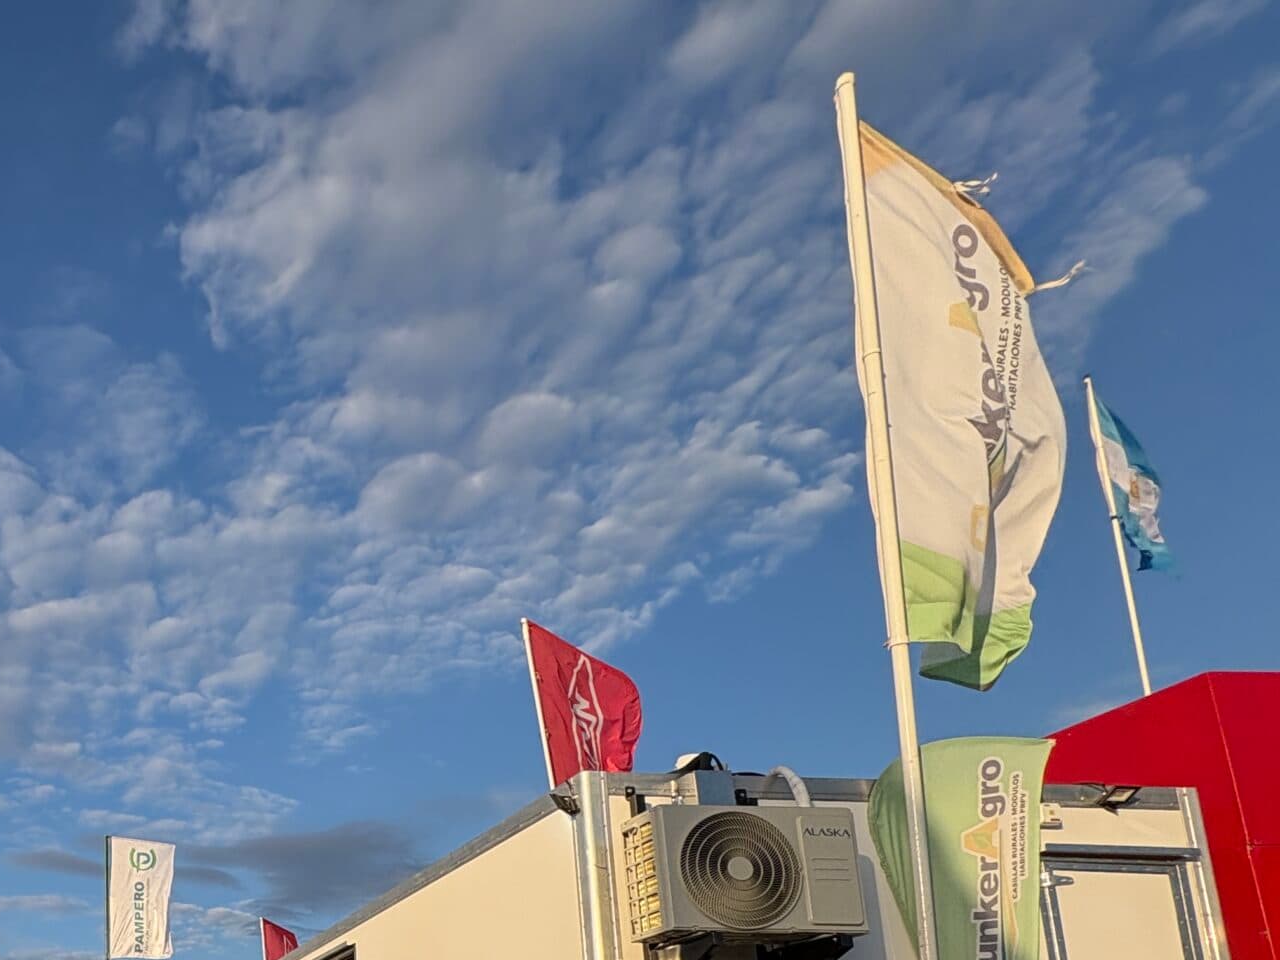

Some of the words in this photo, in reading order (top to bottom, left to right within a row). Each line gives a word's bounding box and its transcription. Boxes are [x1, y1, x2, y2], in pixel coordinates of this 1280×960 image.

[1011, 774, 1020, 815] MODULOS
[803, 827, 851, 837] ALASKA
[134, 881, 145, 953] PAMPERO
